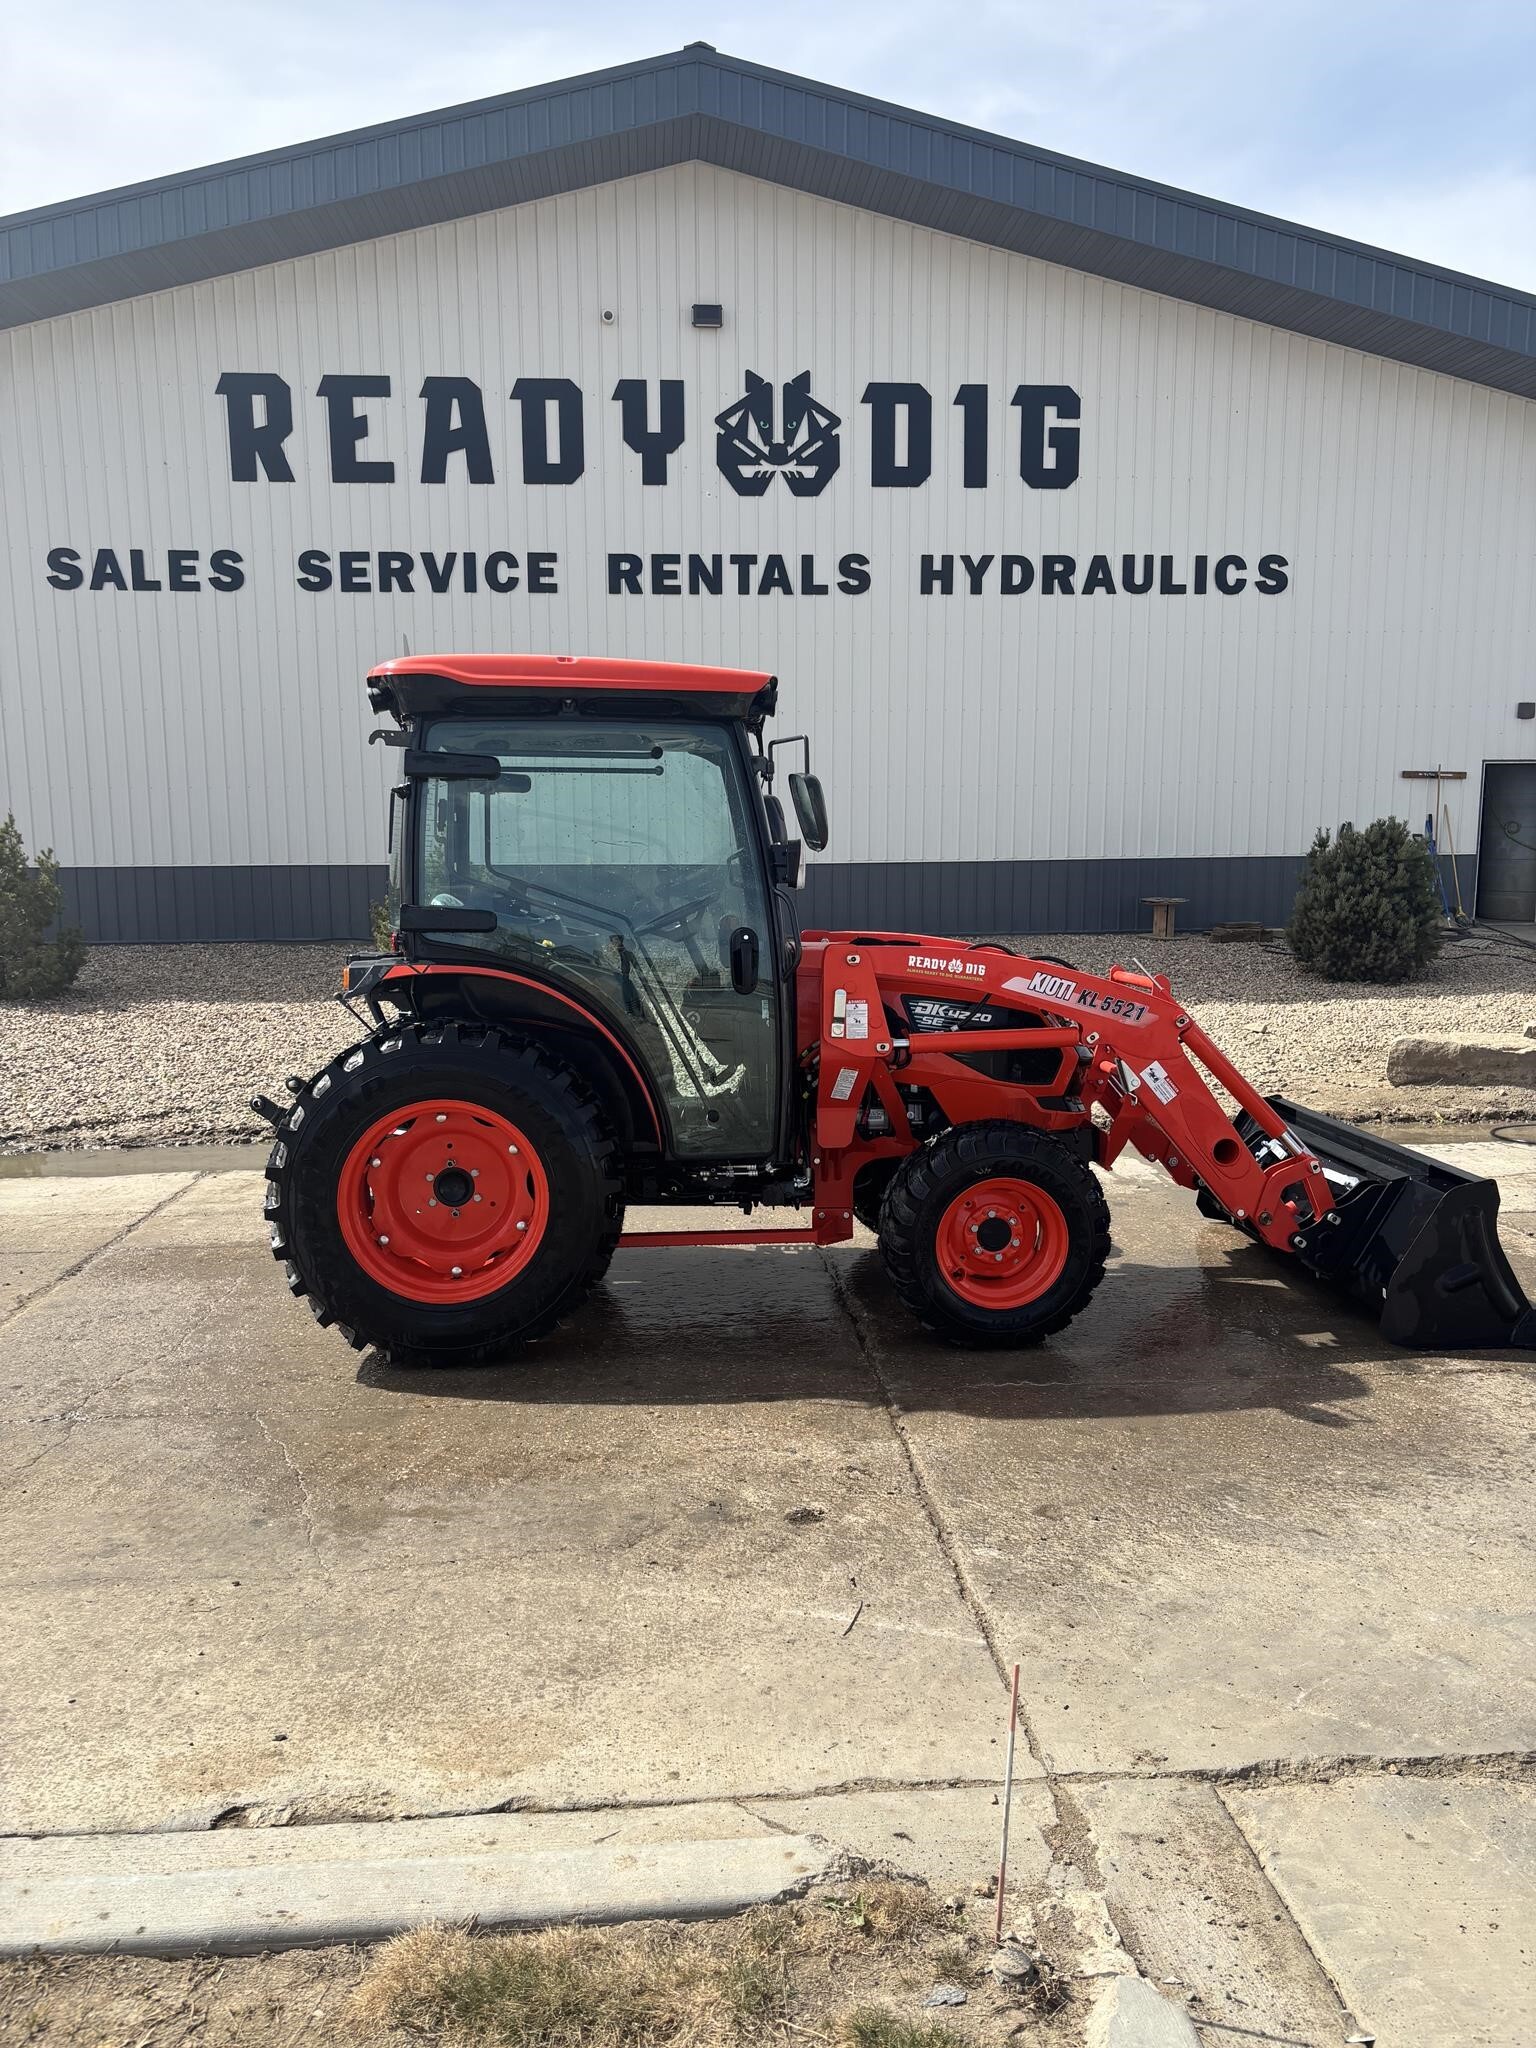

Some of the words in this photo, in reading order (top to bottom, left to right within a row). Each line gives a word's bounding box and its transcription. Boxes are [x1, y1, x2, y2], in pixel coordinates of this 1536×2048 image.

[215, 373, 685, 486] READY
[861, 382, 1081, 489] DIG
[46, 548, 245, 593] SALES
[297, 550, 558, 594] SERVICE
[608, 554, 872, 596] RENTALS
[920, 555, 1289, 596] HYDRAULICS
[908, 955, 947, 971] READY
[965, 962, 987, 976] DIG
[1027, 970, 1078, 1001] KIOTI
[1077, 989, 1099, 1008] KL
[1100, 996, 1147, 1021] 5521
[921, 1016, 945, 1026] SE
